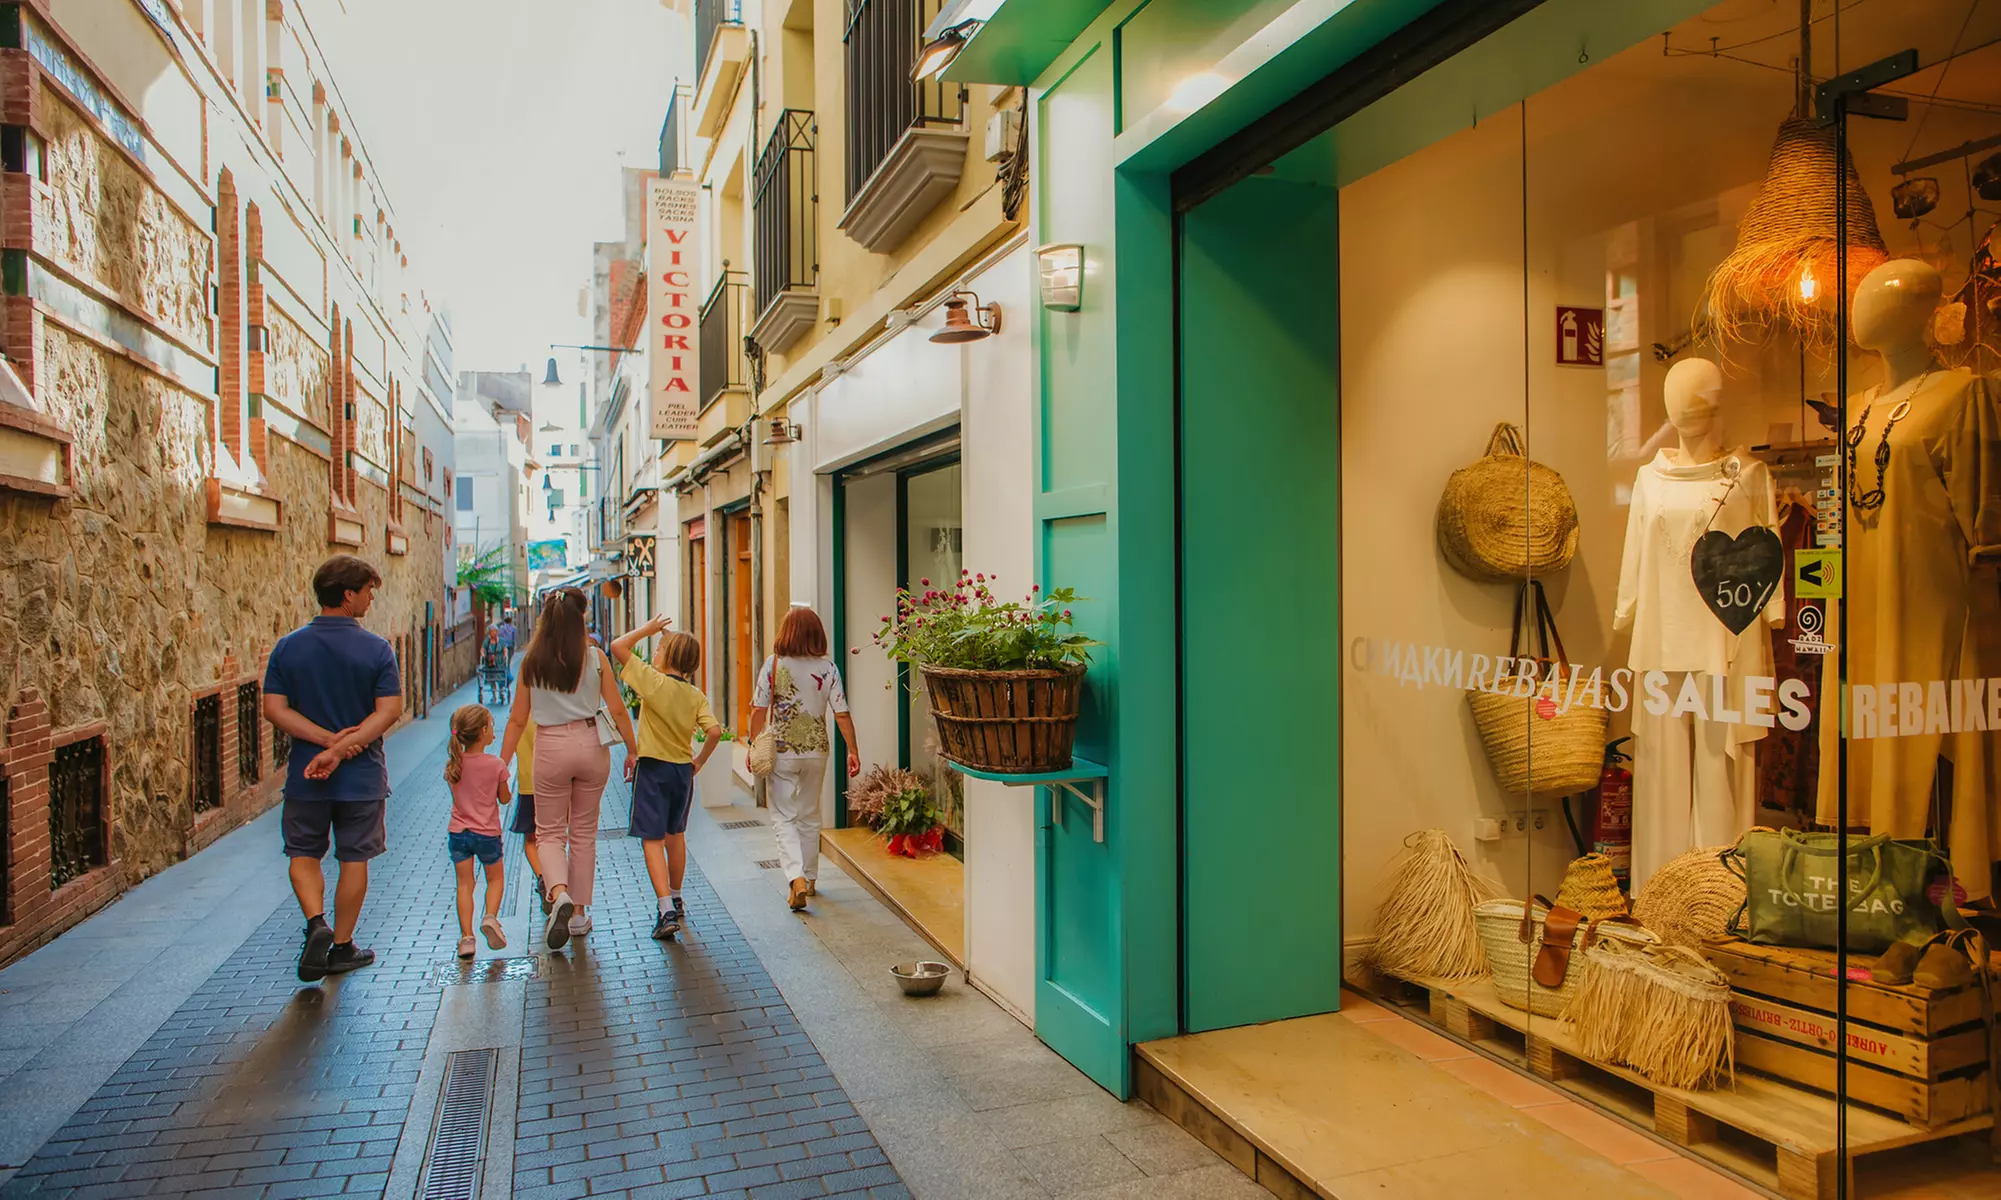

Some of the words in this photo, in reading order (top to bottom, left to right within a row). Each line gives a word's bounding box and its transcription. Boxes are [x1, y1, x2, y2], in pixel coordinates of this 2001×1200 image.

[654, 188, 697, 197] BOLSOS
[661, 229, 691, 392] VICTORIA
[1716, 580, 1773, 613] 50%
[1350, 636, 1463, 690] СКИДКИ
[1465, 653, 1633, 715] REBAJAS
[1643, 671, 1811, 731] SALES
[1852, 678, 2001, 740] REBAIXE
[1768, 888, 1837, 910] TOTE
[1808, 876, 1862, 893] THE
